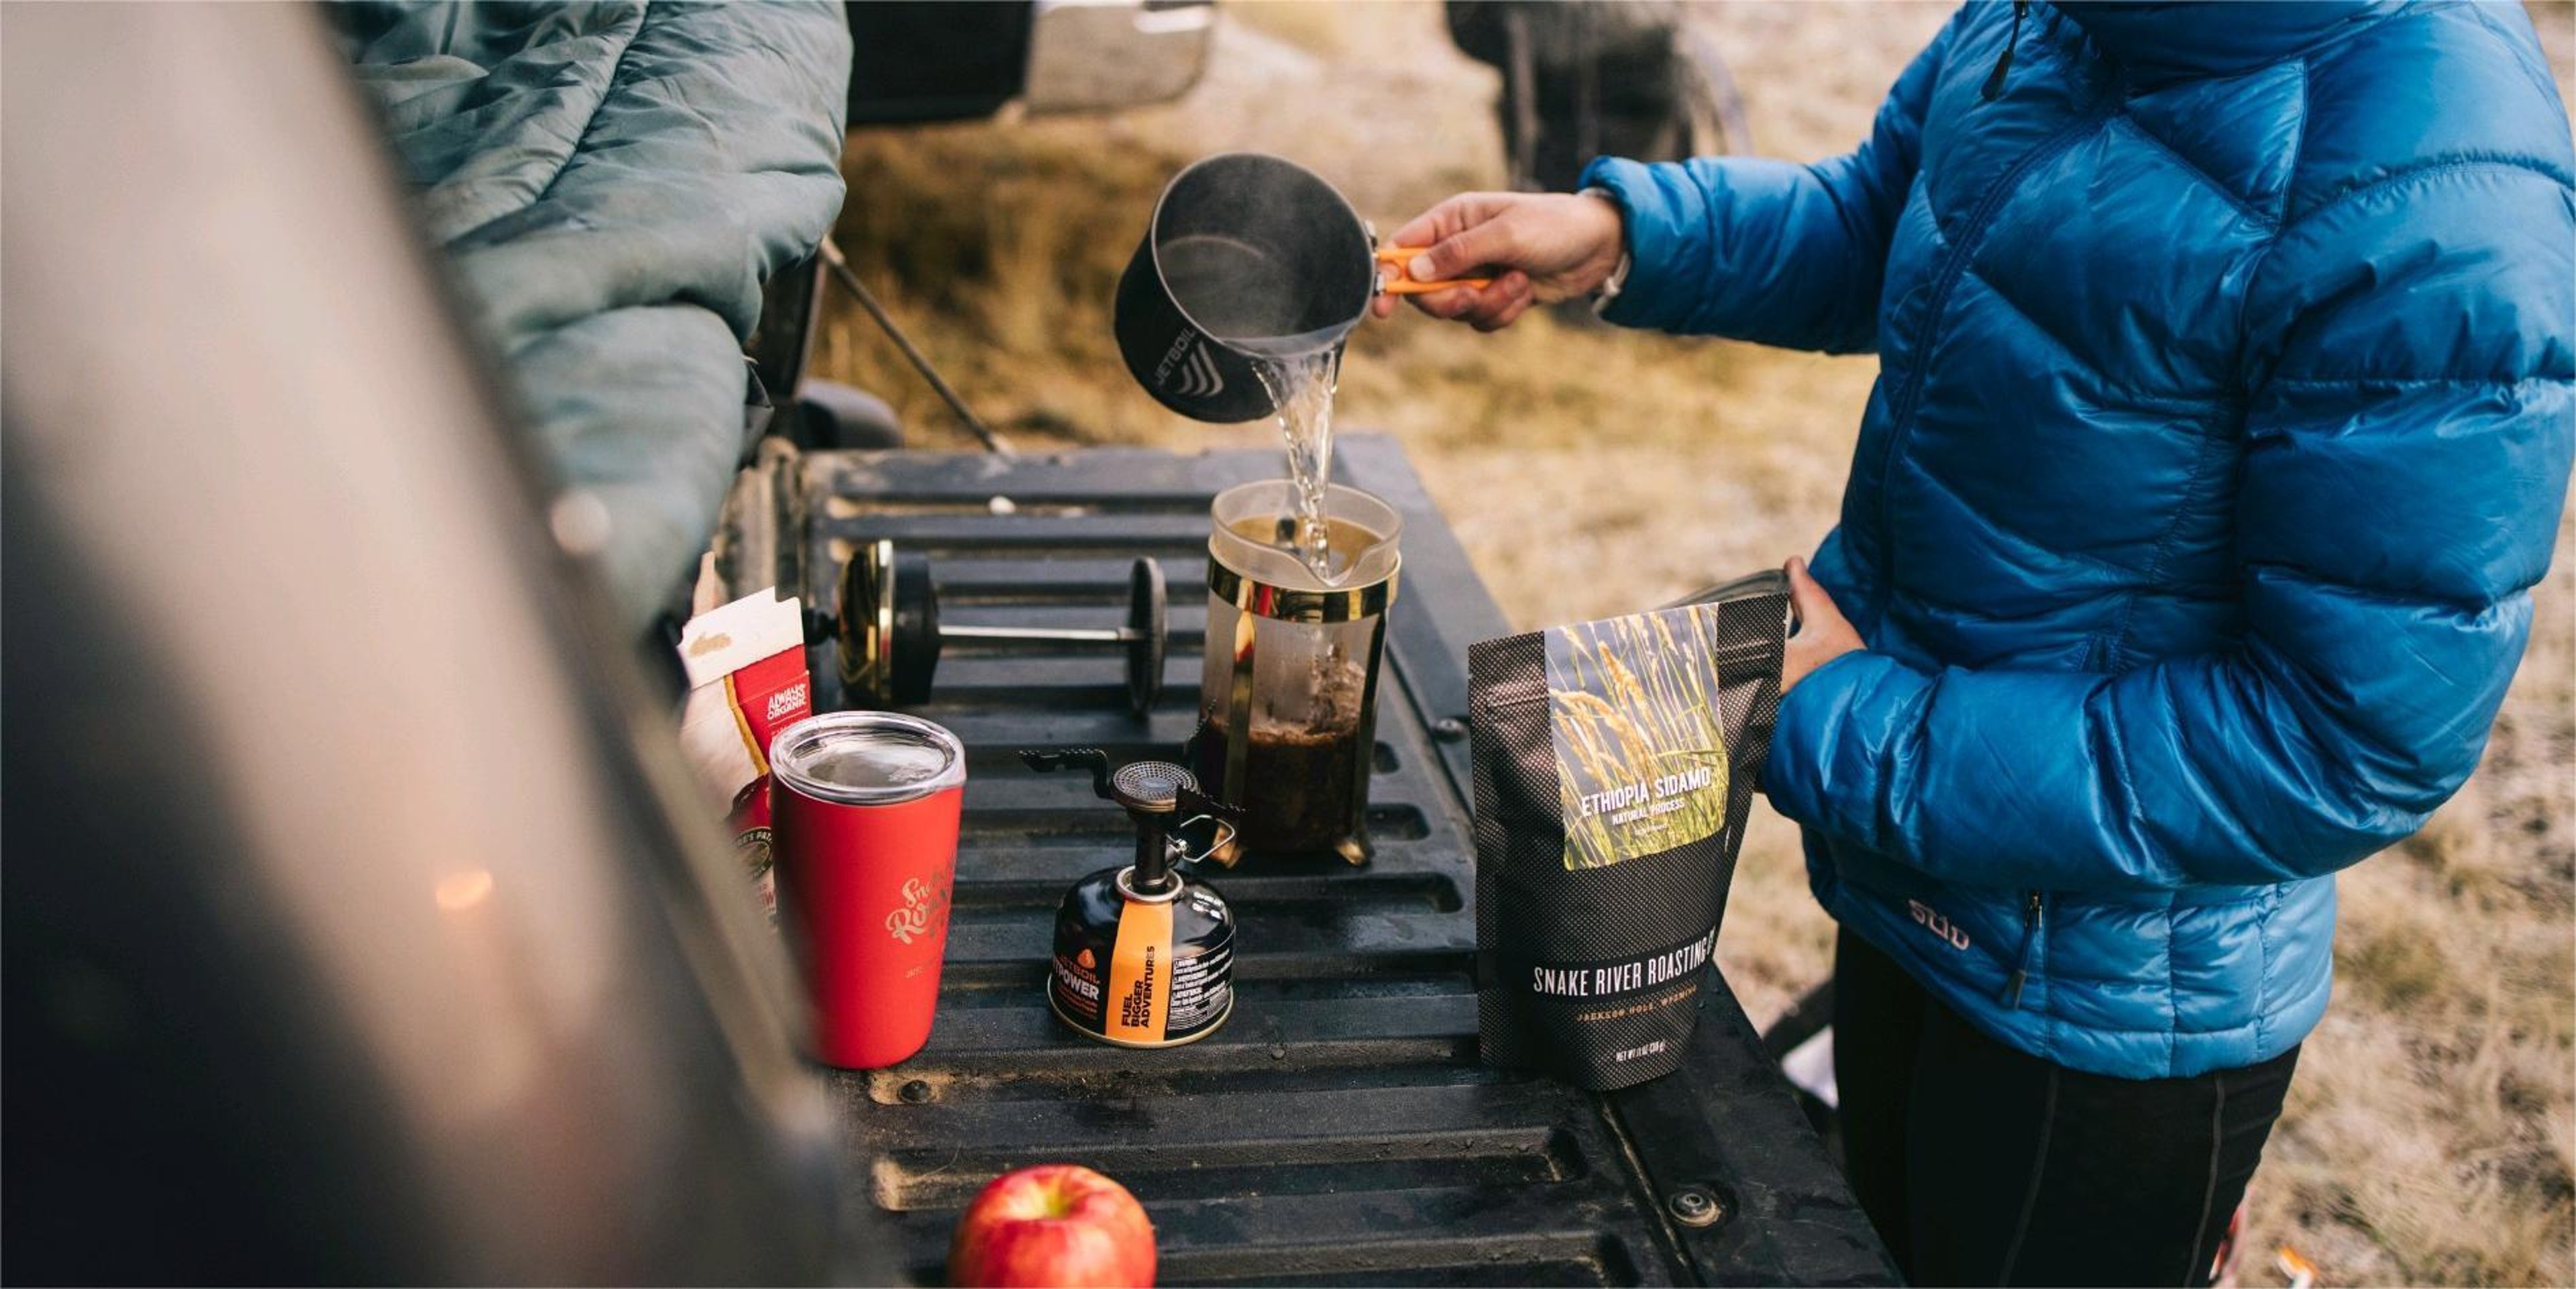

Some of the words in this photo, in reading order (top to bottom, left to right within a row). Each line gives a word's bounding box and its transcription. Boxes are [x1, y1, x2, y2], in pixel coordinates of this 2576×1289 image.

[1154, 327, 1197, 386] JETBOIL
[767, 697, 806, 720] ORGANIC
[768, 683, 806, 711] ALWAYS
[1582, 782, 1650, 817] ETHIOPIA
[1654, 767, 1711, 798] SIDAMO
[1612, 809, 1648, 825] NATURAL
[1650, 798, 1685, 817] PROCESS
[1141, 946, 1155, 1028] ADVENTURES
[1534, 967, 1589, 996] SNAKE
[1595, 962, 1642, 995] RIVER
[1648, 937, 1707, 985] ROASTING
[1122, 993, 1133, 1026] FUEL
[1131, 980, 1143, 1027] BIGGER
